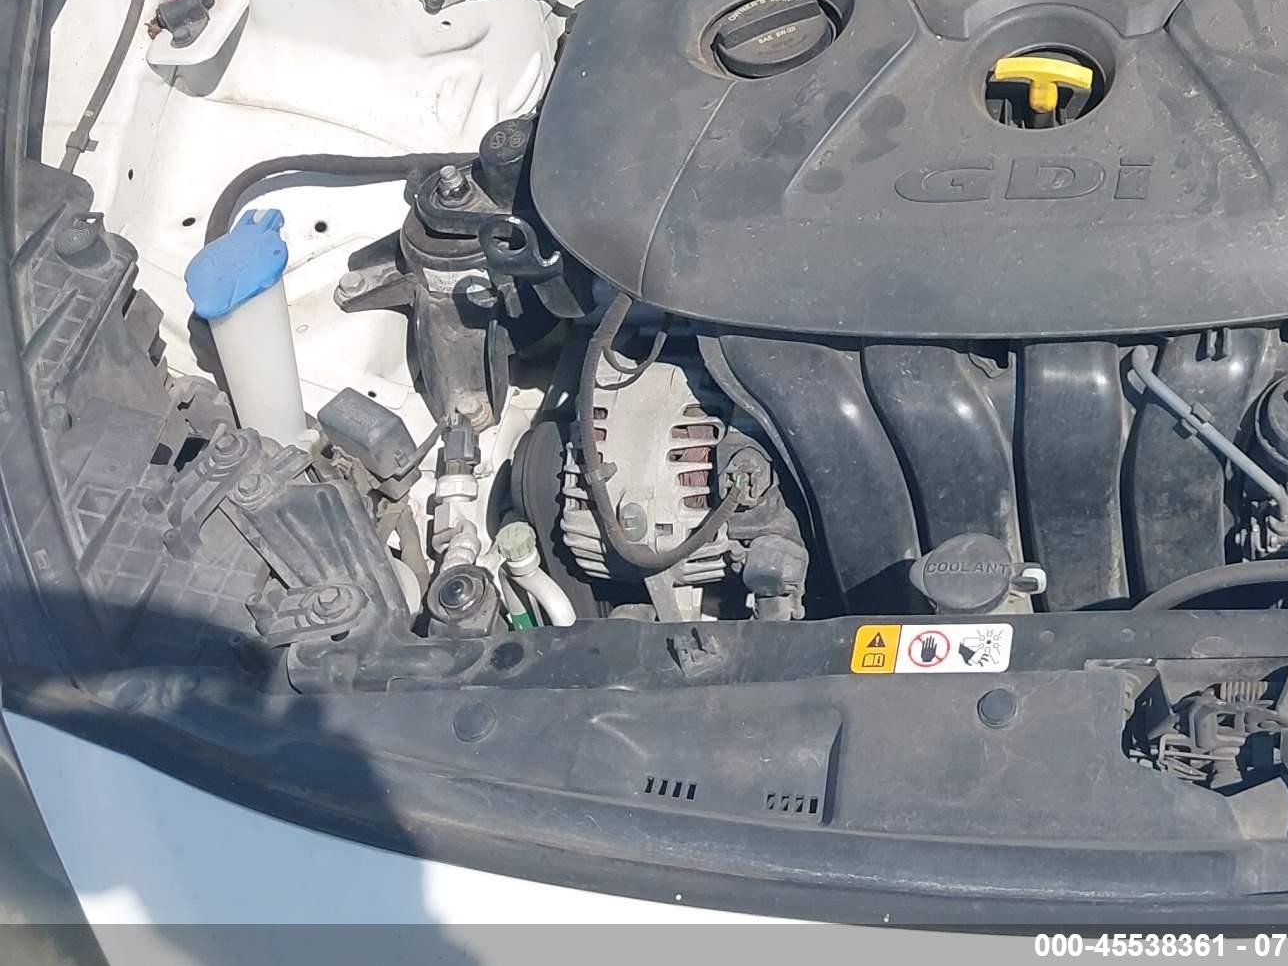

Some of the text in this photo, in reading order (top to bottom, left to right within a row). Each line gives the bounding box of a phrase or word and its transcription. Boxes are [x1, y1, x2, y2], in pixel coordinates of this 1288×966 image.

[758, 34, 774, 44] SAE
[893, 154, 1156, 204] GDi
[925, 560, 1010, 575] COOLANT
